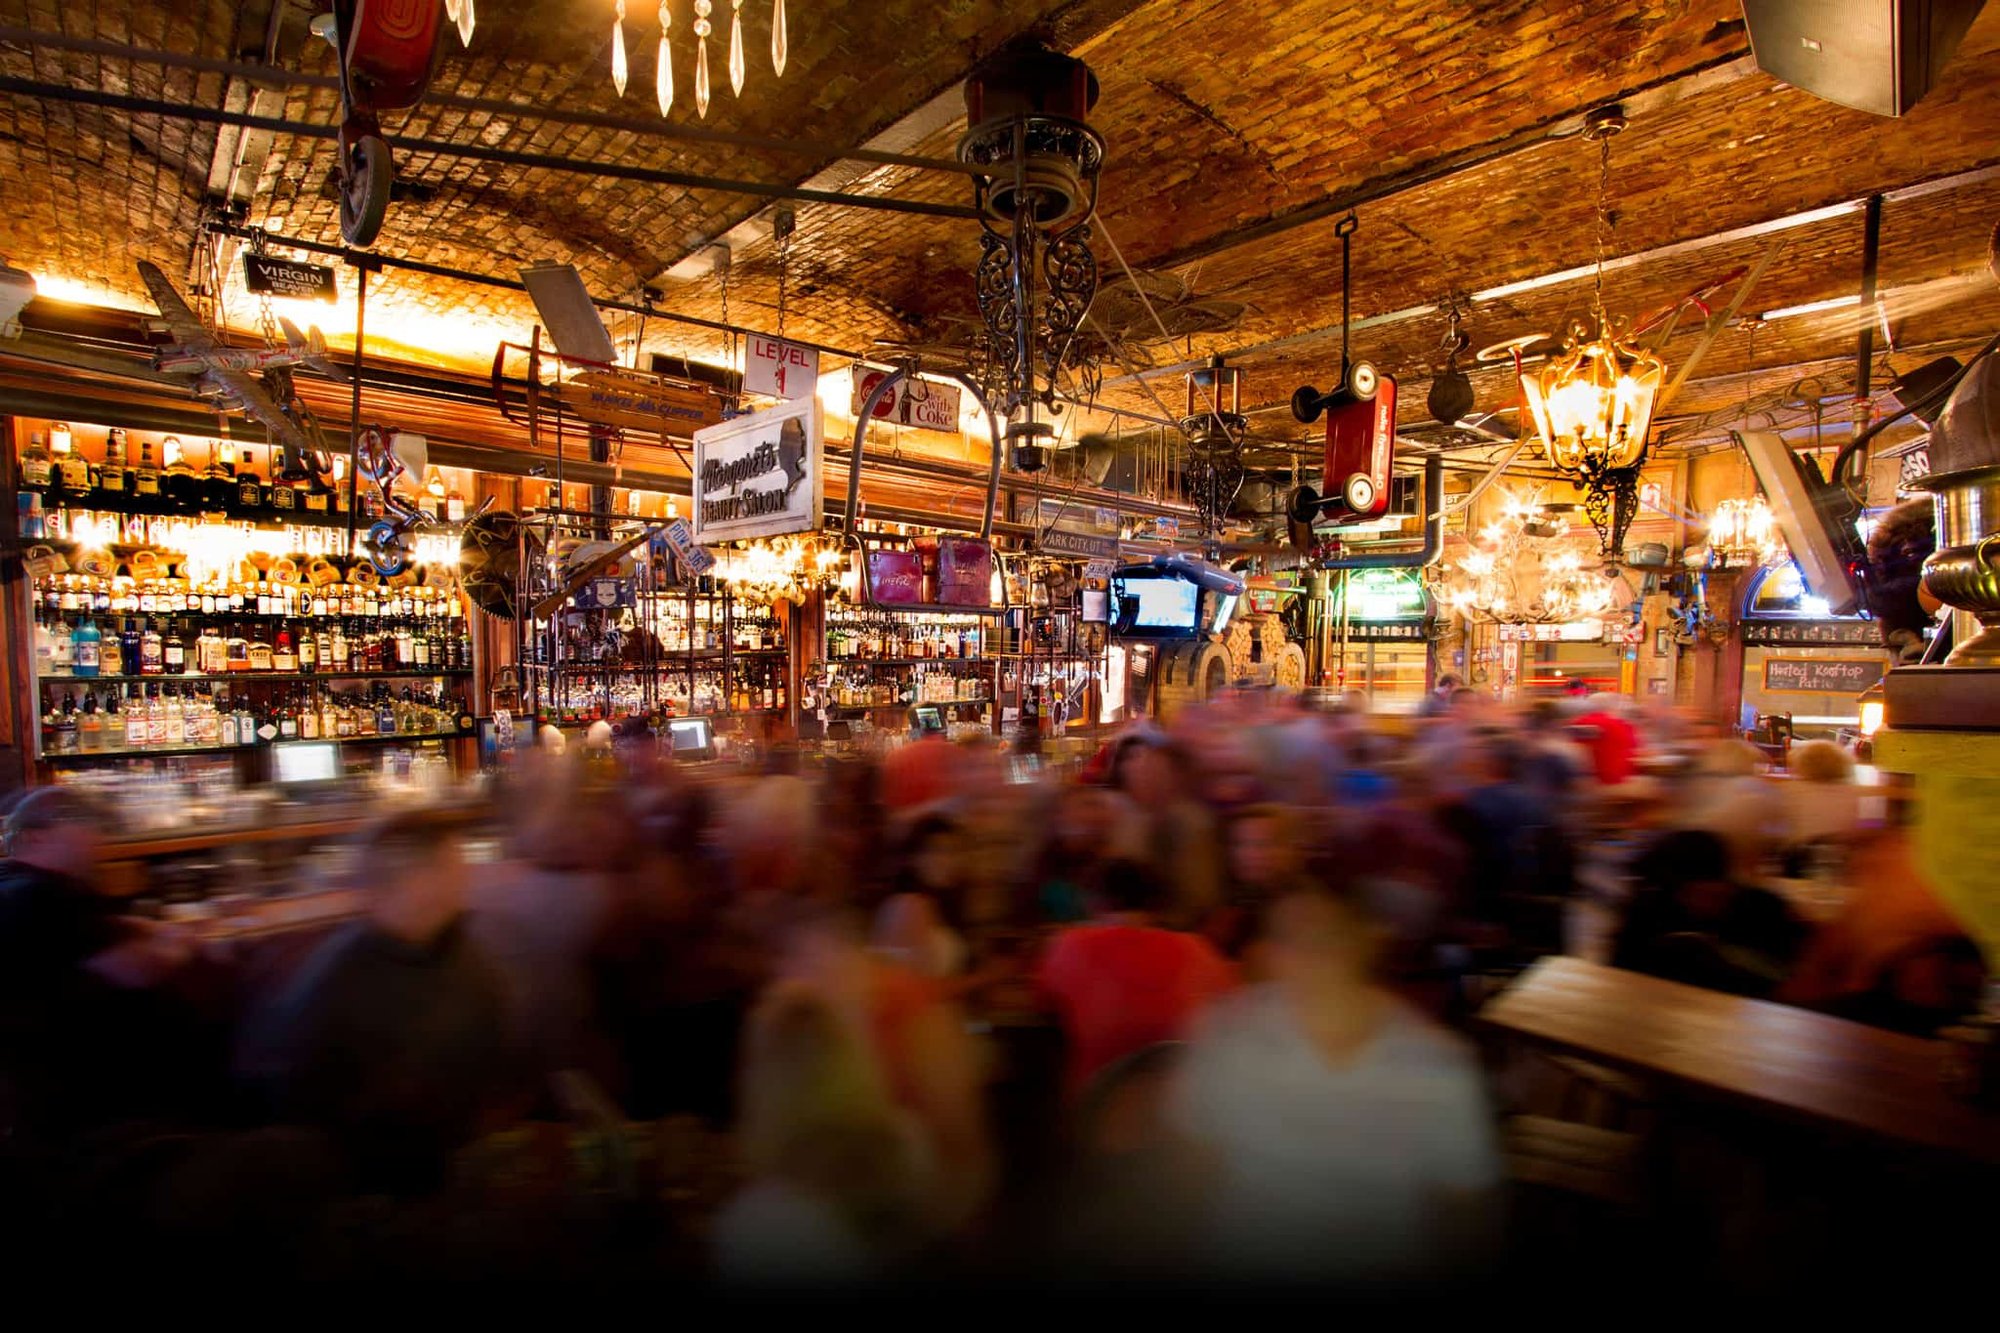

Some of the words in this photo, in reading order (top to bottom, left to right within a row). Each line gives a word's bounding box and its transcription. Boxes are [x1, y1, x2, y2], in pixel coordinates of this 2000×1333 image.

[257, 264, 324, 285] VIRGIN
[756, 340, 810, 368] LEVEL
[916, 403, 953, 426] Coke
[702, 497, 741, 524] BEAUTY
[742, 488, 788, 518] SALON
[1089, 540, 1101, 553] UT
[1815, 663, 1864, 679] Rooftop
